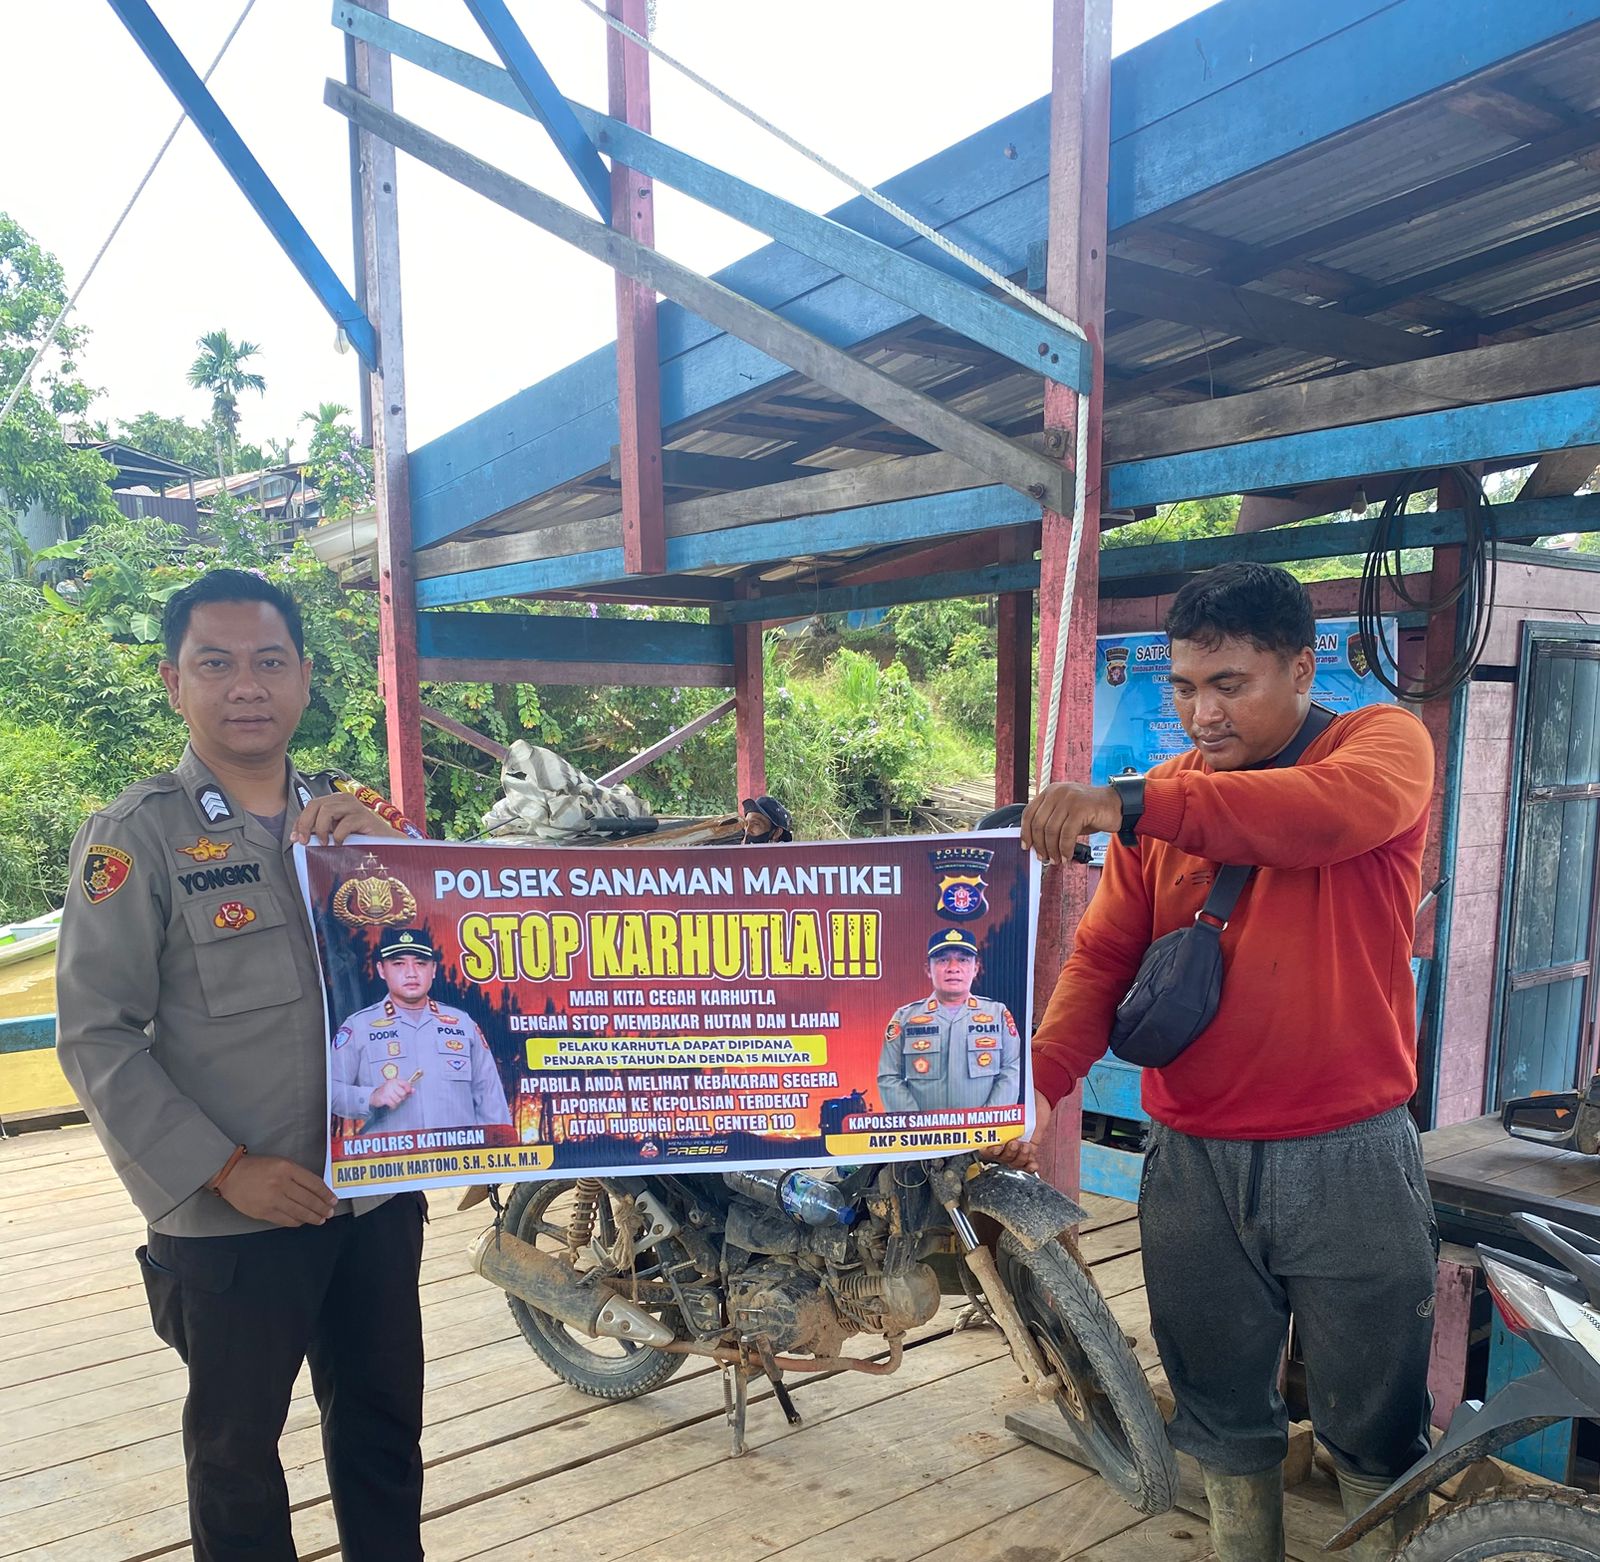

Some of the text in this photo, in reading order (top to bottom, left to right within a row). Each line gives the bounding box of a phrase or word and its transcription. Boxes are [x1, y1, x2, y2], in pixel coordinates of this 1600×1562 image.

[177, 863, 261, 896] YONGKY
[434, 865, 901, 899] POLSEK SANAMAN MANTIKEI
[459, 911, 881, 982] STOP KARHUTLA !!!
[569, 989, 776, 1007] MARI KITA CEGAH KARHUTLA
[437, 1026, 466, 1037] POLRI
[510, 1012, 840, 1031] DENGAN STOP MEMBAKAR HUTAN DAN LAHAN
[968, 1024, 999, 1034] POLRI
[369, 1030, 400, 1042] DODIK
[559, 1039, 793, 1052] PELAKU KARHUTLA DAPAT DIPIDANA
[544, 1053, 810, 1066] PENJARA 15 TAHUN DAN DENDA 15 MILYAR
[520, 1072, 838, 1094] APABILA ANDA MELIHAT KEBAKARAN SEGERA
[552, 1094, 808, 1115] LAPORKAN KE KEPOLISIAN TERDEKAT
[569, 1114, 795, 1135] ATAU HUBUNGI CALL CENTER 110
[848, 1108, 1022, 1131] KAPOLSEK SANAMAN MANTIKEI
[343, 1129, 485, 1156] KAPOLRES KATINGAN
[869, 1130, 1001, 1148] AKP SUWARDI, S.H.
[666, 1145, 728, 1156] PRESISI
[337, 1167, 367, 1183] AKBP
[369, 1161, 404, 1179] DODIK
[463, 1155, 486, 1170] S.H.,
[487, 1154, 516, 1168] S.I.K.,
[518, 1152, 541, 1166] M.H.
